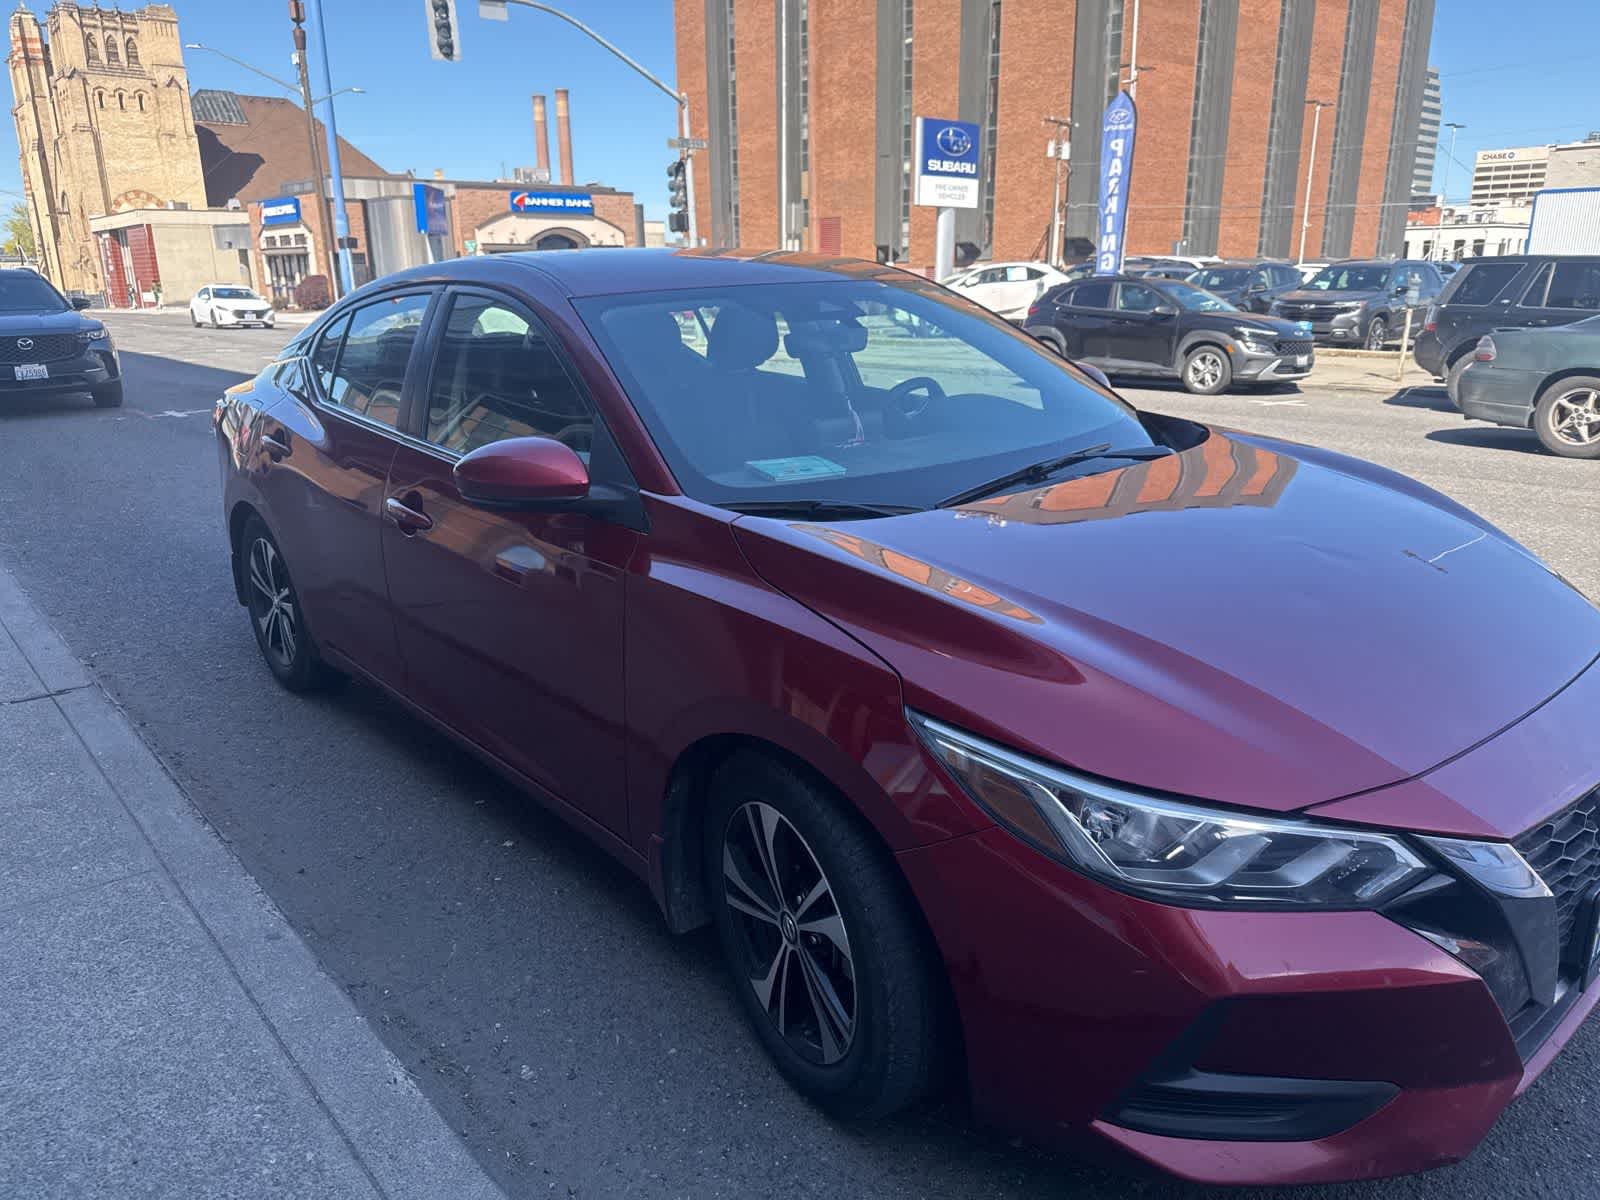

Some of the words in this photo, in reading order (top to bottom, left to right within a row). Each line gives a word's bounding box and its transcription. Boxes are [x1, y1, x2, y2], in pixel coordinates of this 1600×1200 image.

[1481, 152, 1507, 160] CHASE
[927, 159, 976, 174] SUBARU
[525, 196, 564, 207] BANNER
[565, 198, 593, 208] BANK
